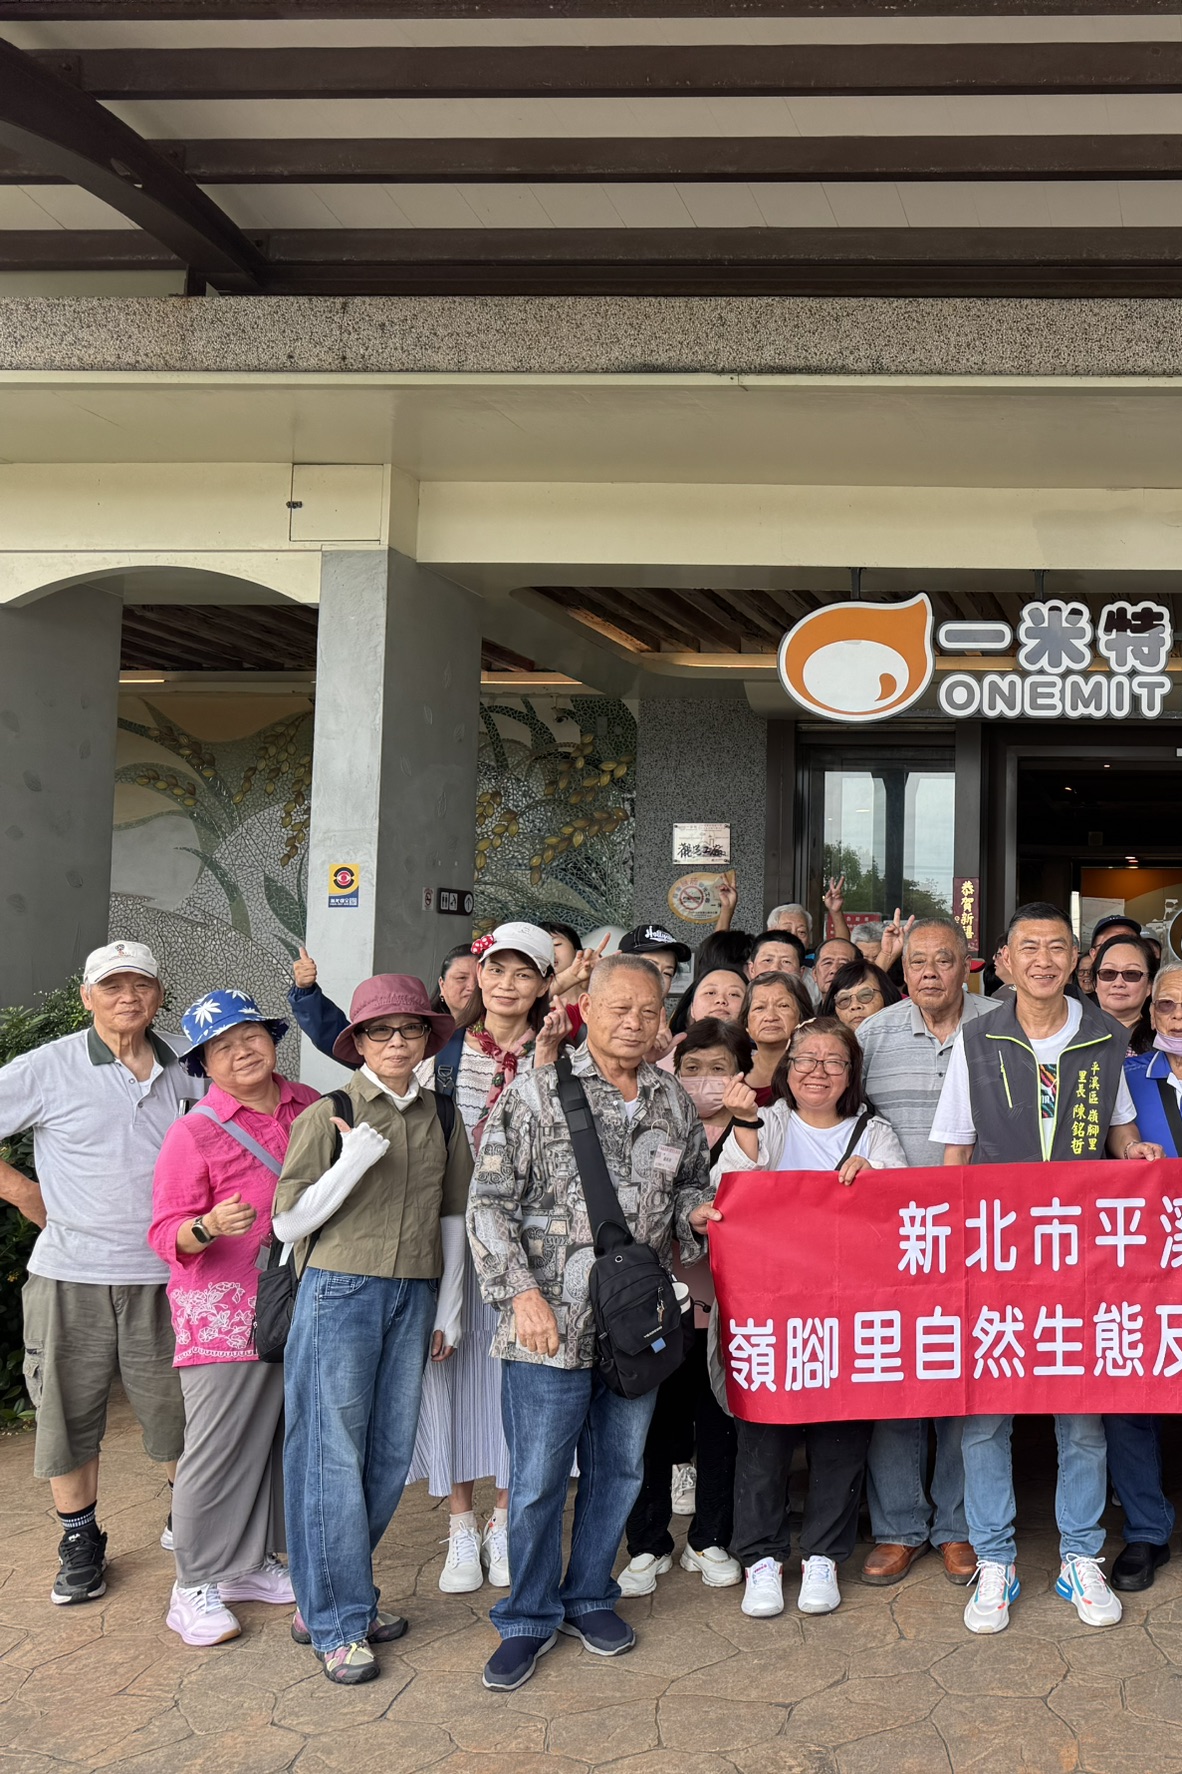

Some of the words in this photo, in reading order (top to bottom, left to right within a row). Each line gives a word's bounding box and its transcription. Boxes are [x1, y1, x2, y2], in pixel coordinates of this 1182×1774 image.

[941, 602, 1170, 671] 一米特
[941, 675, 1170, 717] ONEMIT
